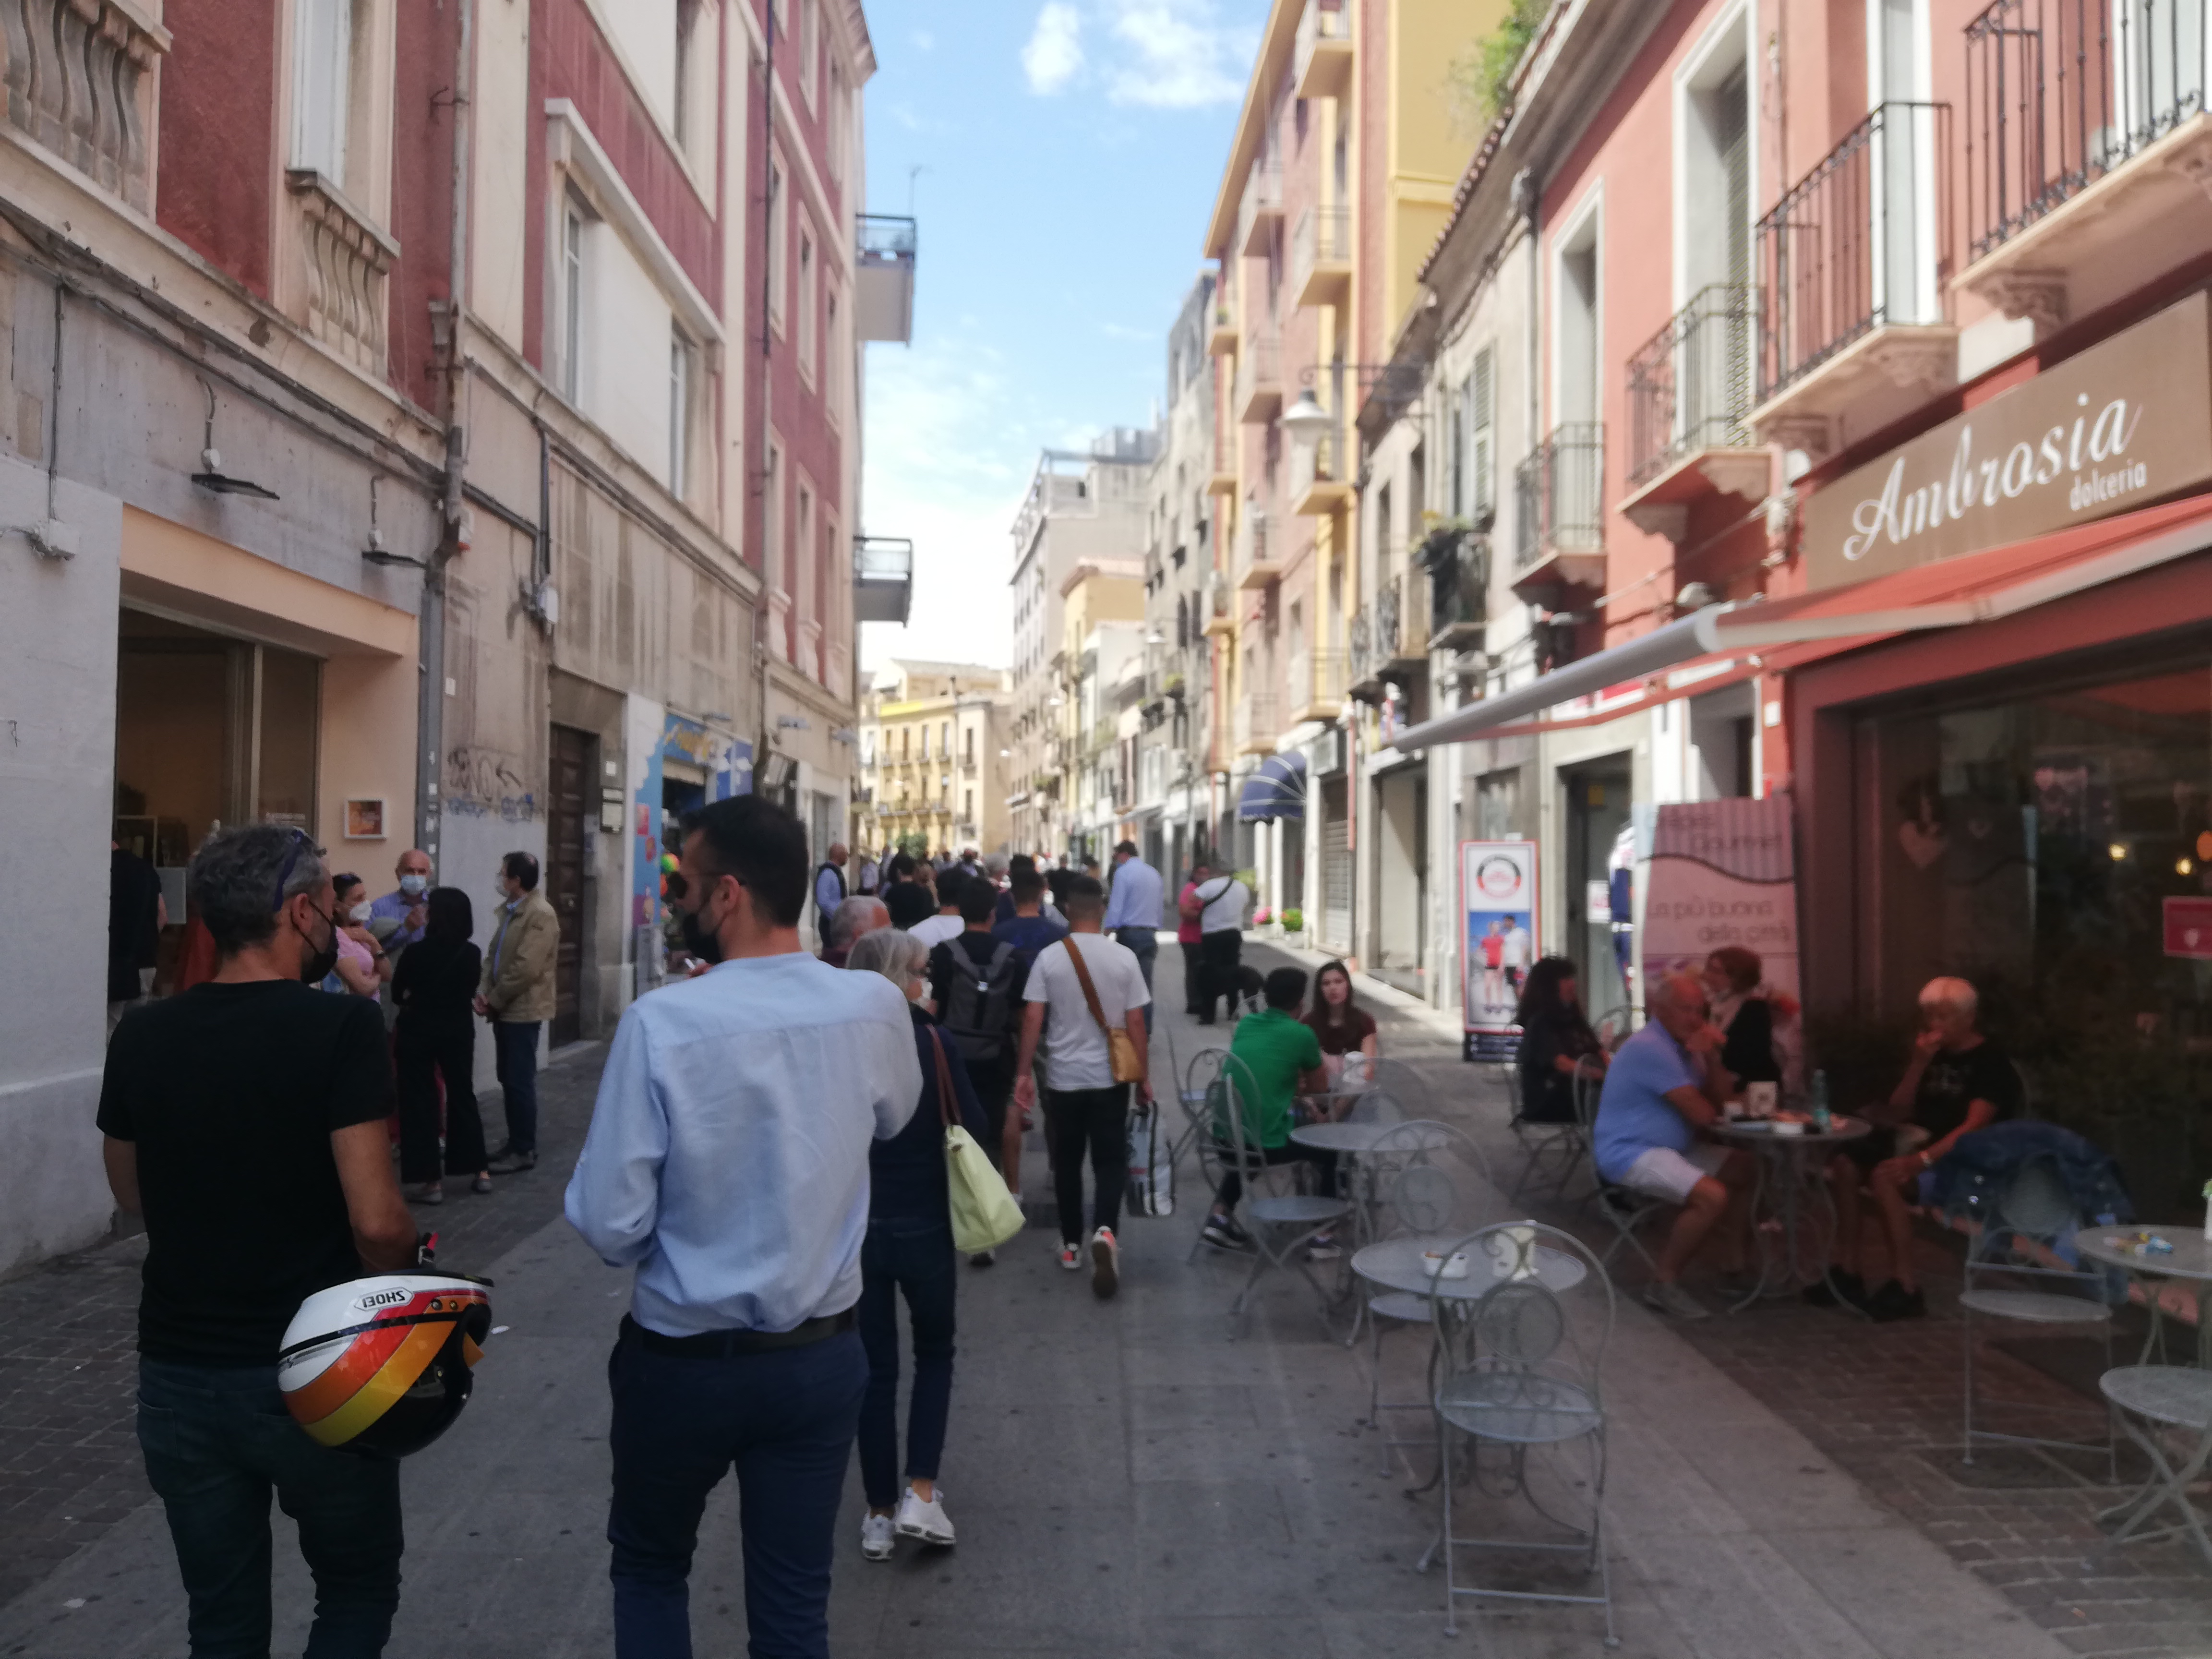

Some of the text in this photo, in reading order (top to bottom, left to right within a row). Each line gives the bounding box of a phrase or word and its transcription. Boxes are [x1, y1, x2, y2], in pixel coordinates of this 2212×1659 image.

[1842, 392, 2143, 560] Ambrosia
[2069, 459, 2147, 511] dolceria
[362, 1290, 406, 1308] SHOEI
